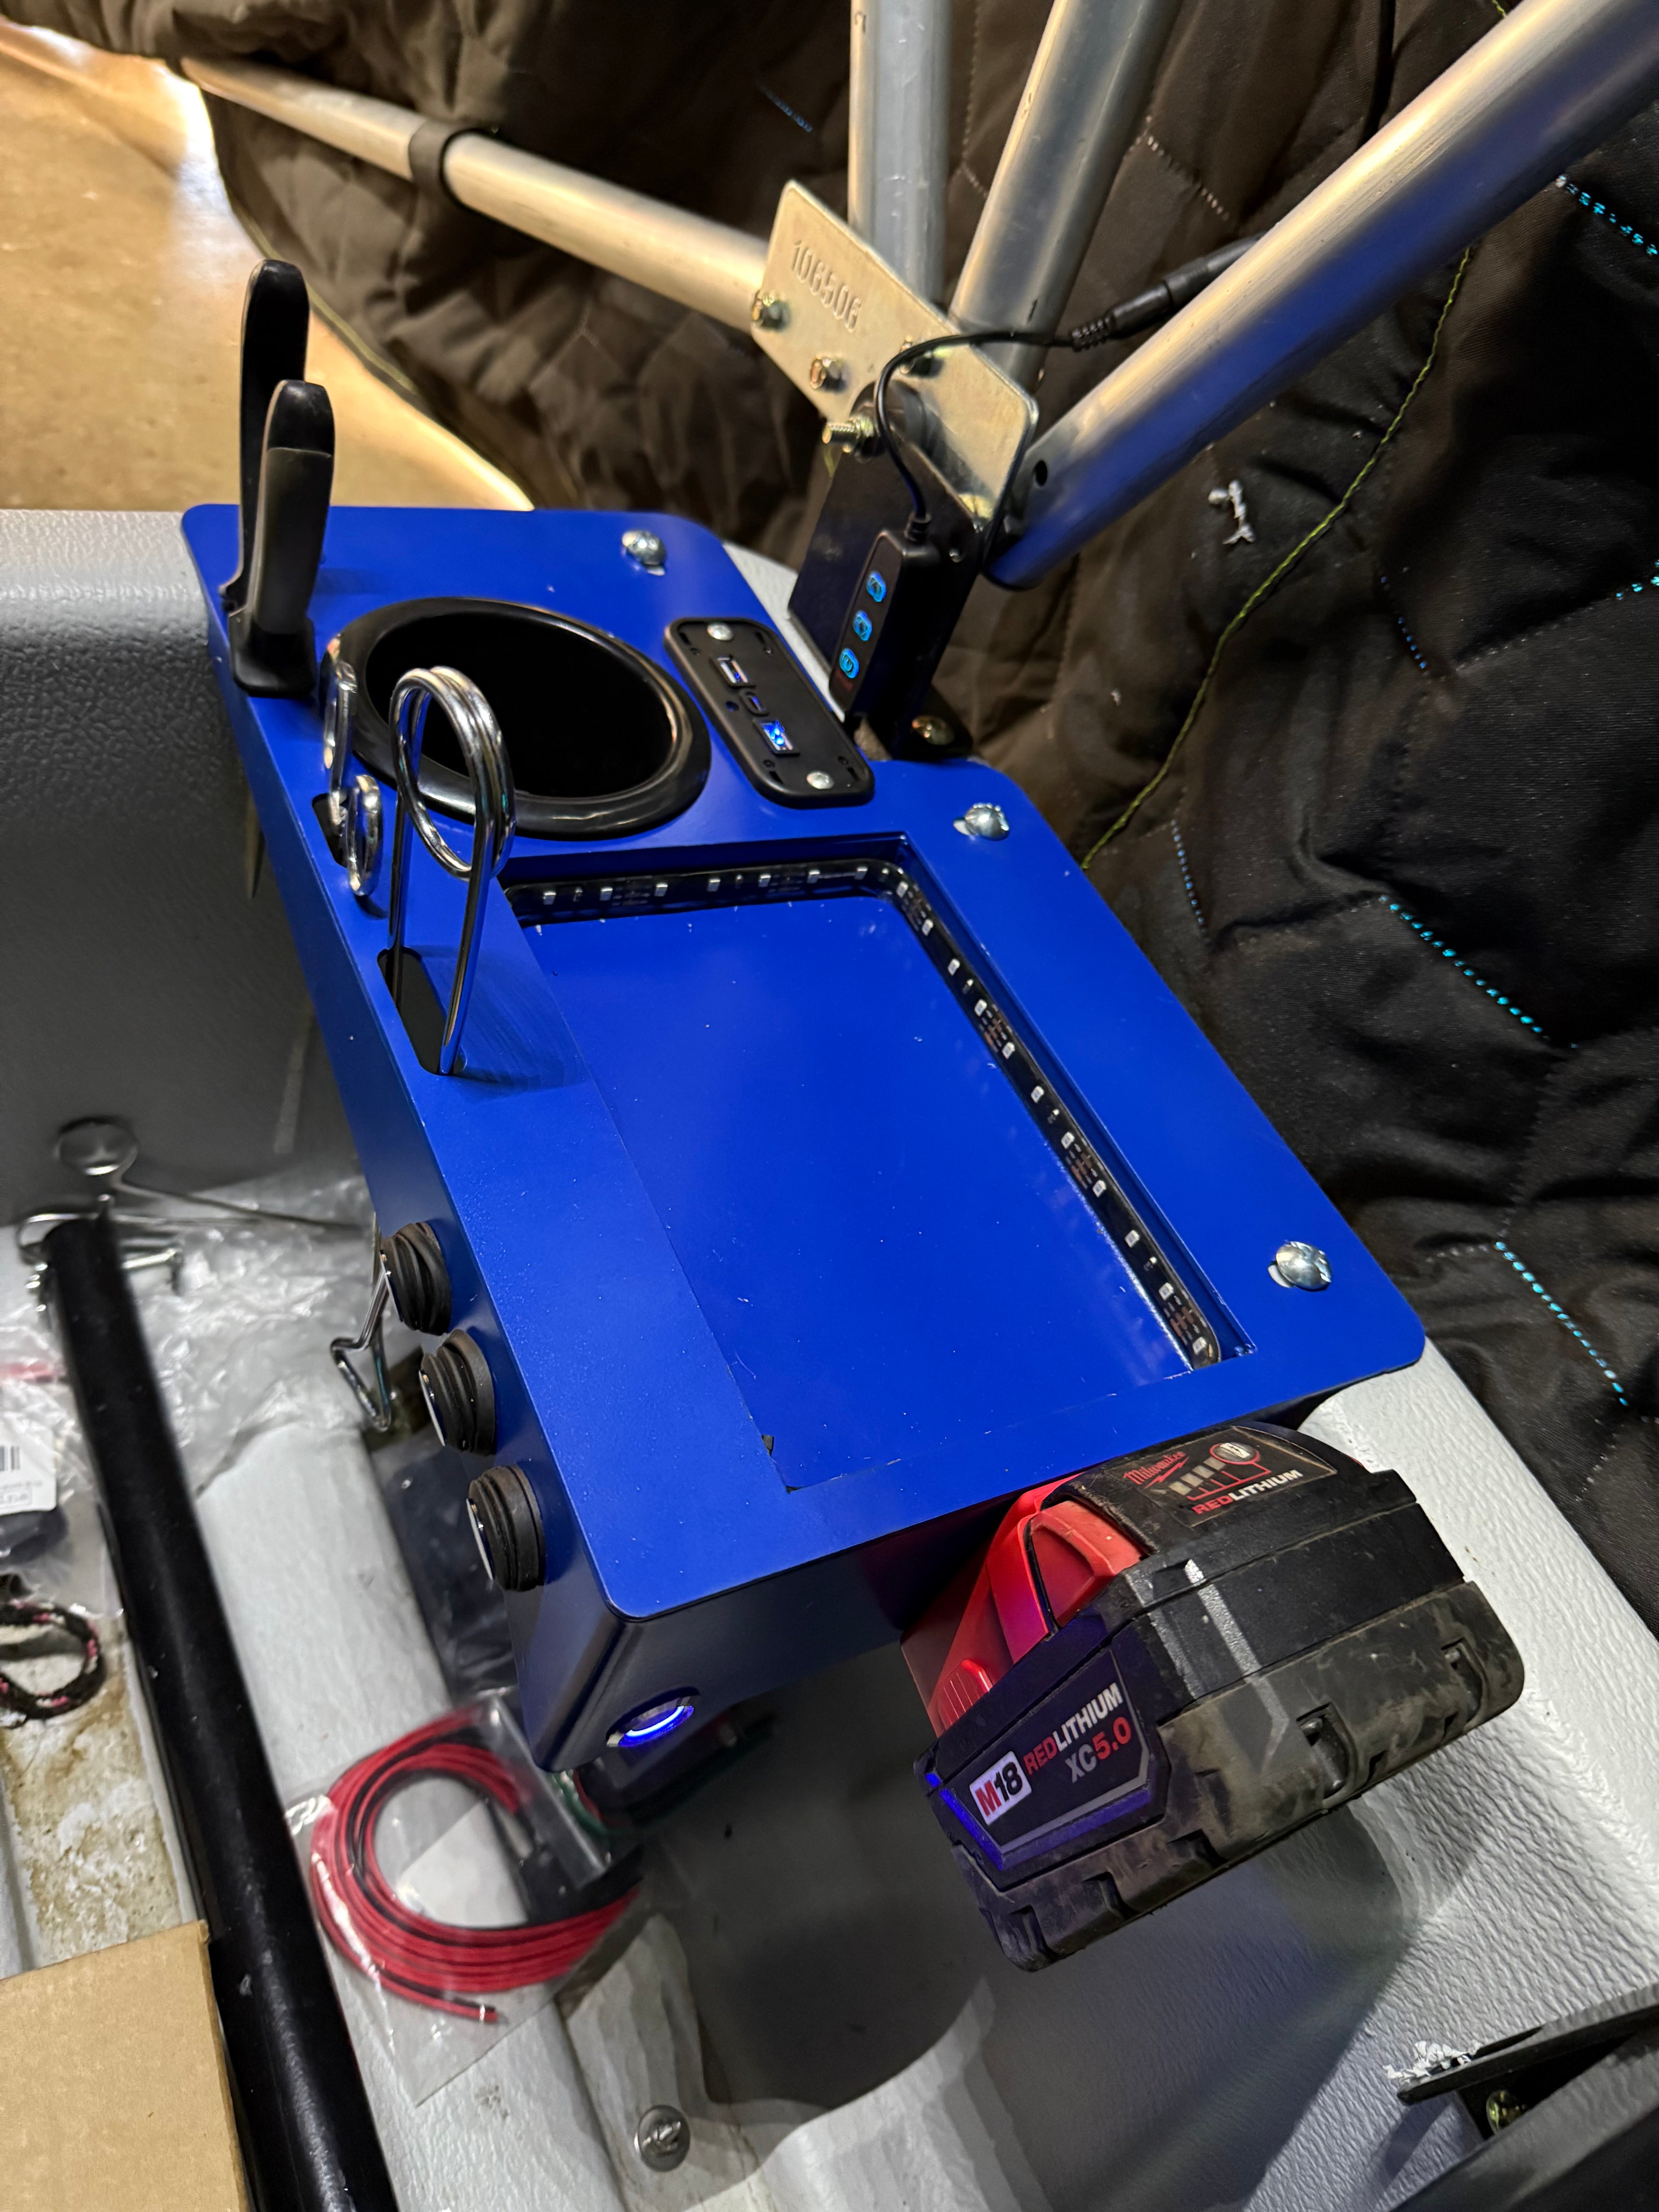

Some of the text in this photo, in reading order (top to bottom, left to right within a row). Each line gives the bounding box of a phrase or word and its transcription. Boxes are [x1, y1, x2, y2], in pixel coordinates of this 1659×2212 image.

[791, 240, 862, 333] 106506
[1123, 1451, 1186, 1485] Milwaukee
[1191, 1469, 1303, 1515] REDLITHIUM
[975, 1682, 1124, 1817] M18 REDLITHIUM
[1065, 1716, 1132, 1783] XC5.0
